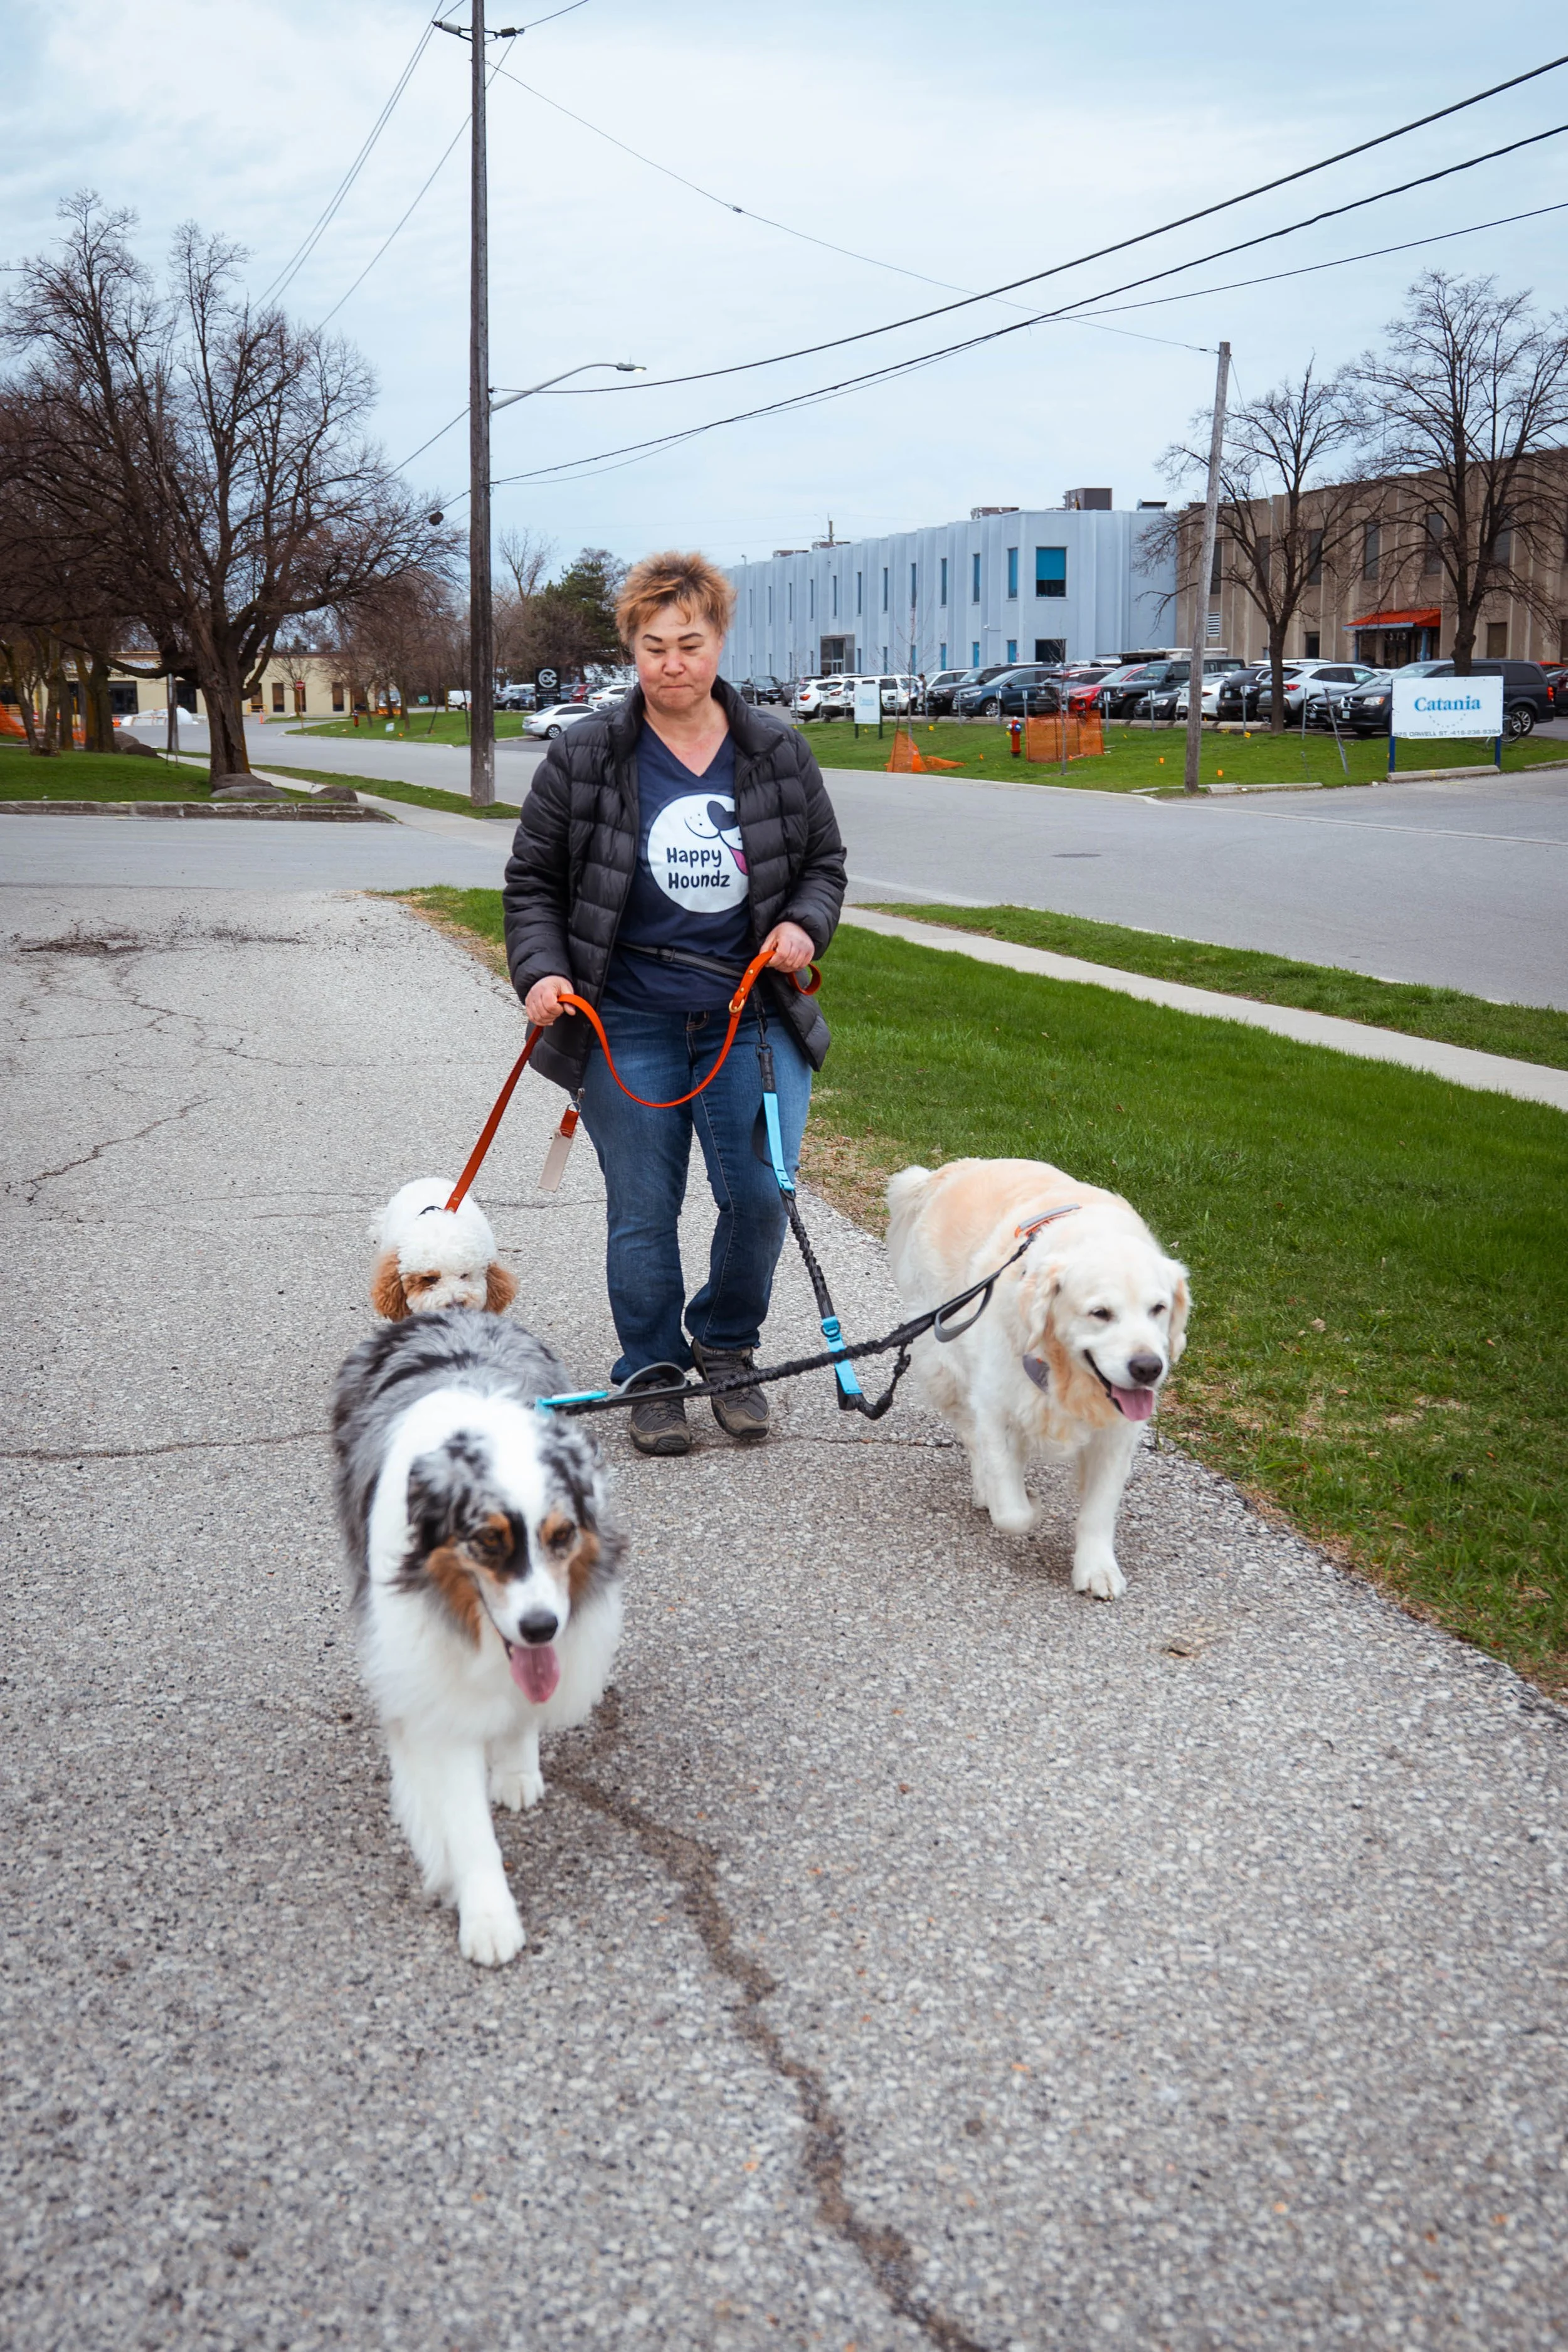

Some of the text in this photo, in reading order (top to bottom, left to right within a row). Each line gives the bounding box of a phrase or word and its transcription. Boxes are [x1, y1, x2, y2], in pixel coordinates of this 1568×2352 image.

[1414, 695, 1481, 712] Catania
[667, 847, 721, 868] Happy
[668, 870, 730, 889] Houndz
